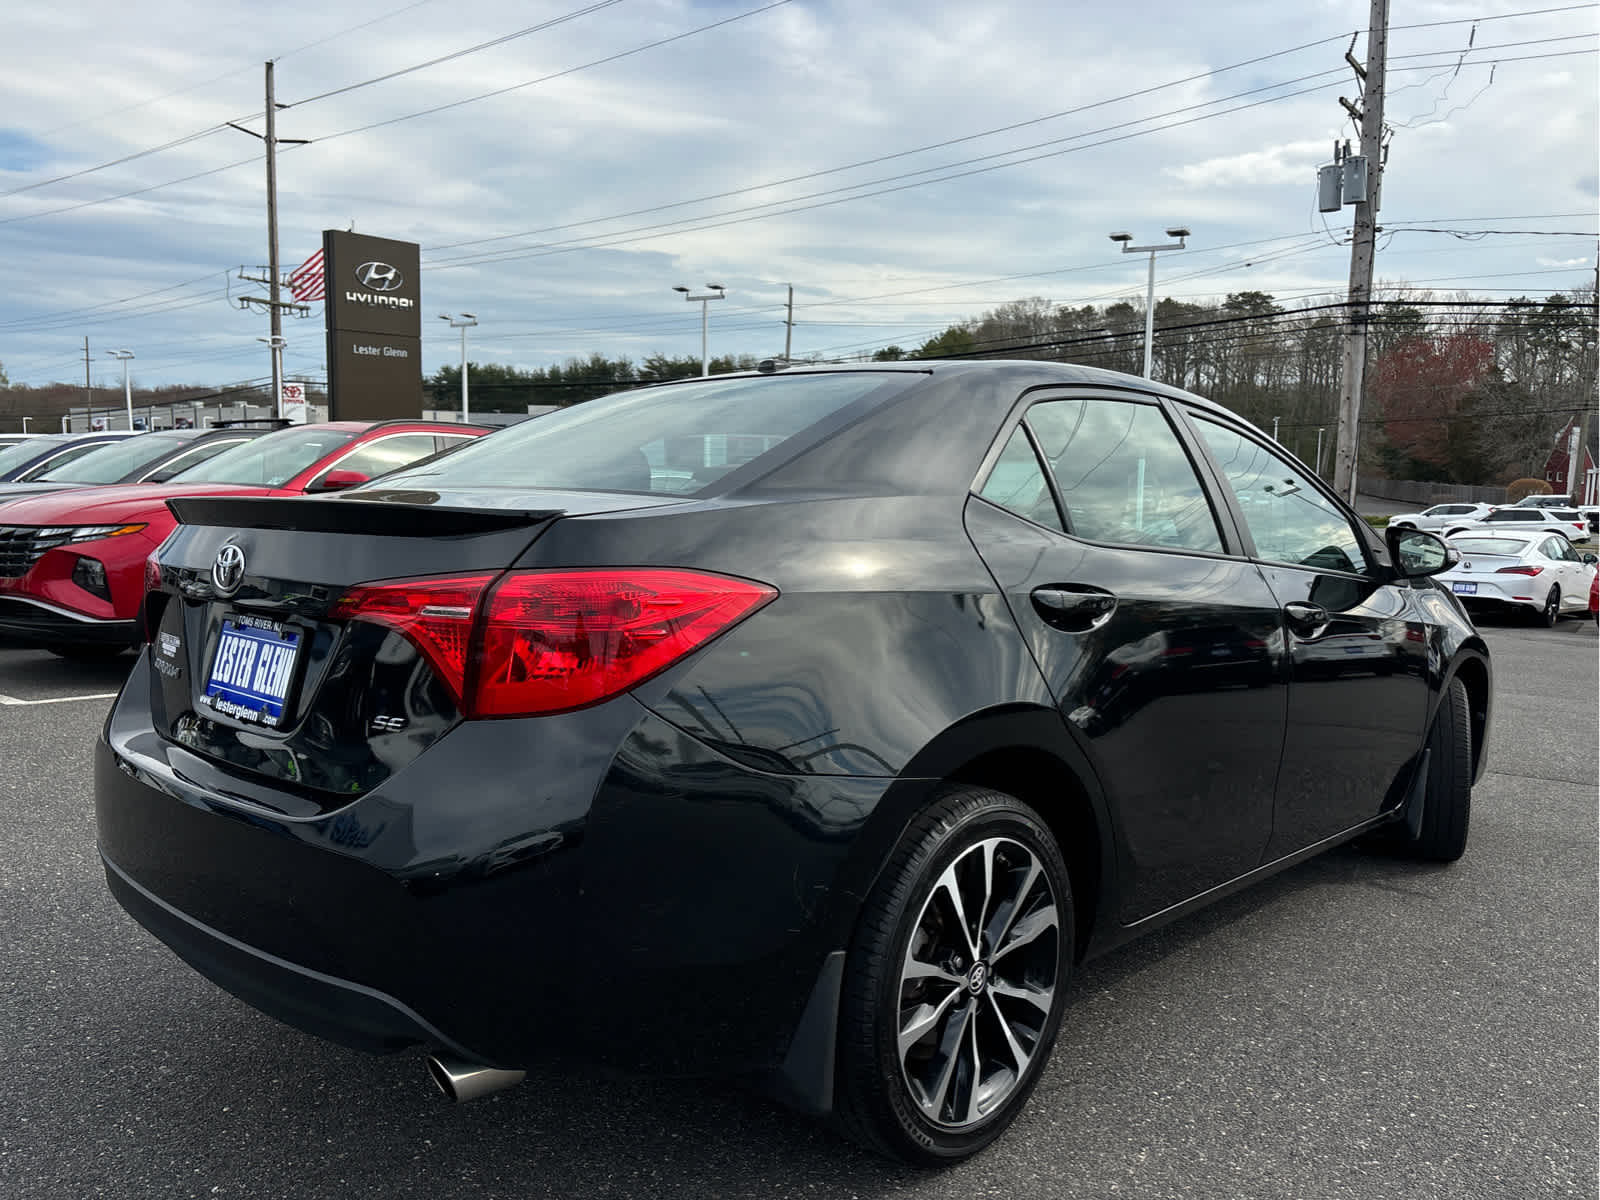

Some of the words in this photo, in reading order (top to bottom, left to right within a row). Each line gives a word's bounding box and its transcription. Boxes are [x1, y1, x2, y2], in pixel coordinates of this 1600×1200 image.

[345, 291, 414, 308] HYUNDAI
[353, 344, 381, 356] Lester
[383, 346, 409, 358] Glenn
[239, 615, 255, 627] TOMS
[273, 621, 283, 632] NJ
[212, 635, 257, 689] LESTER
[253, 643, 297, 699] GLENN
[215, 697, 258, 721] lesterglenn
[371, 715, 405, 732] SE
